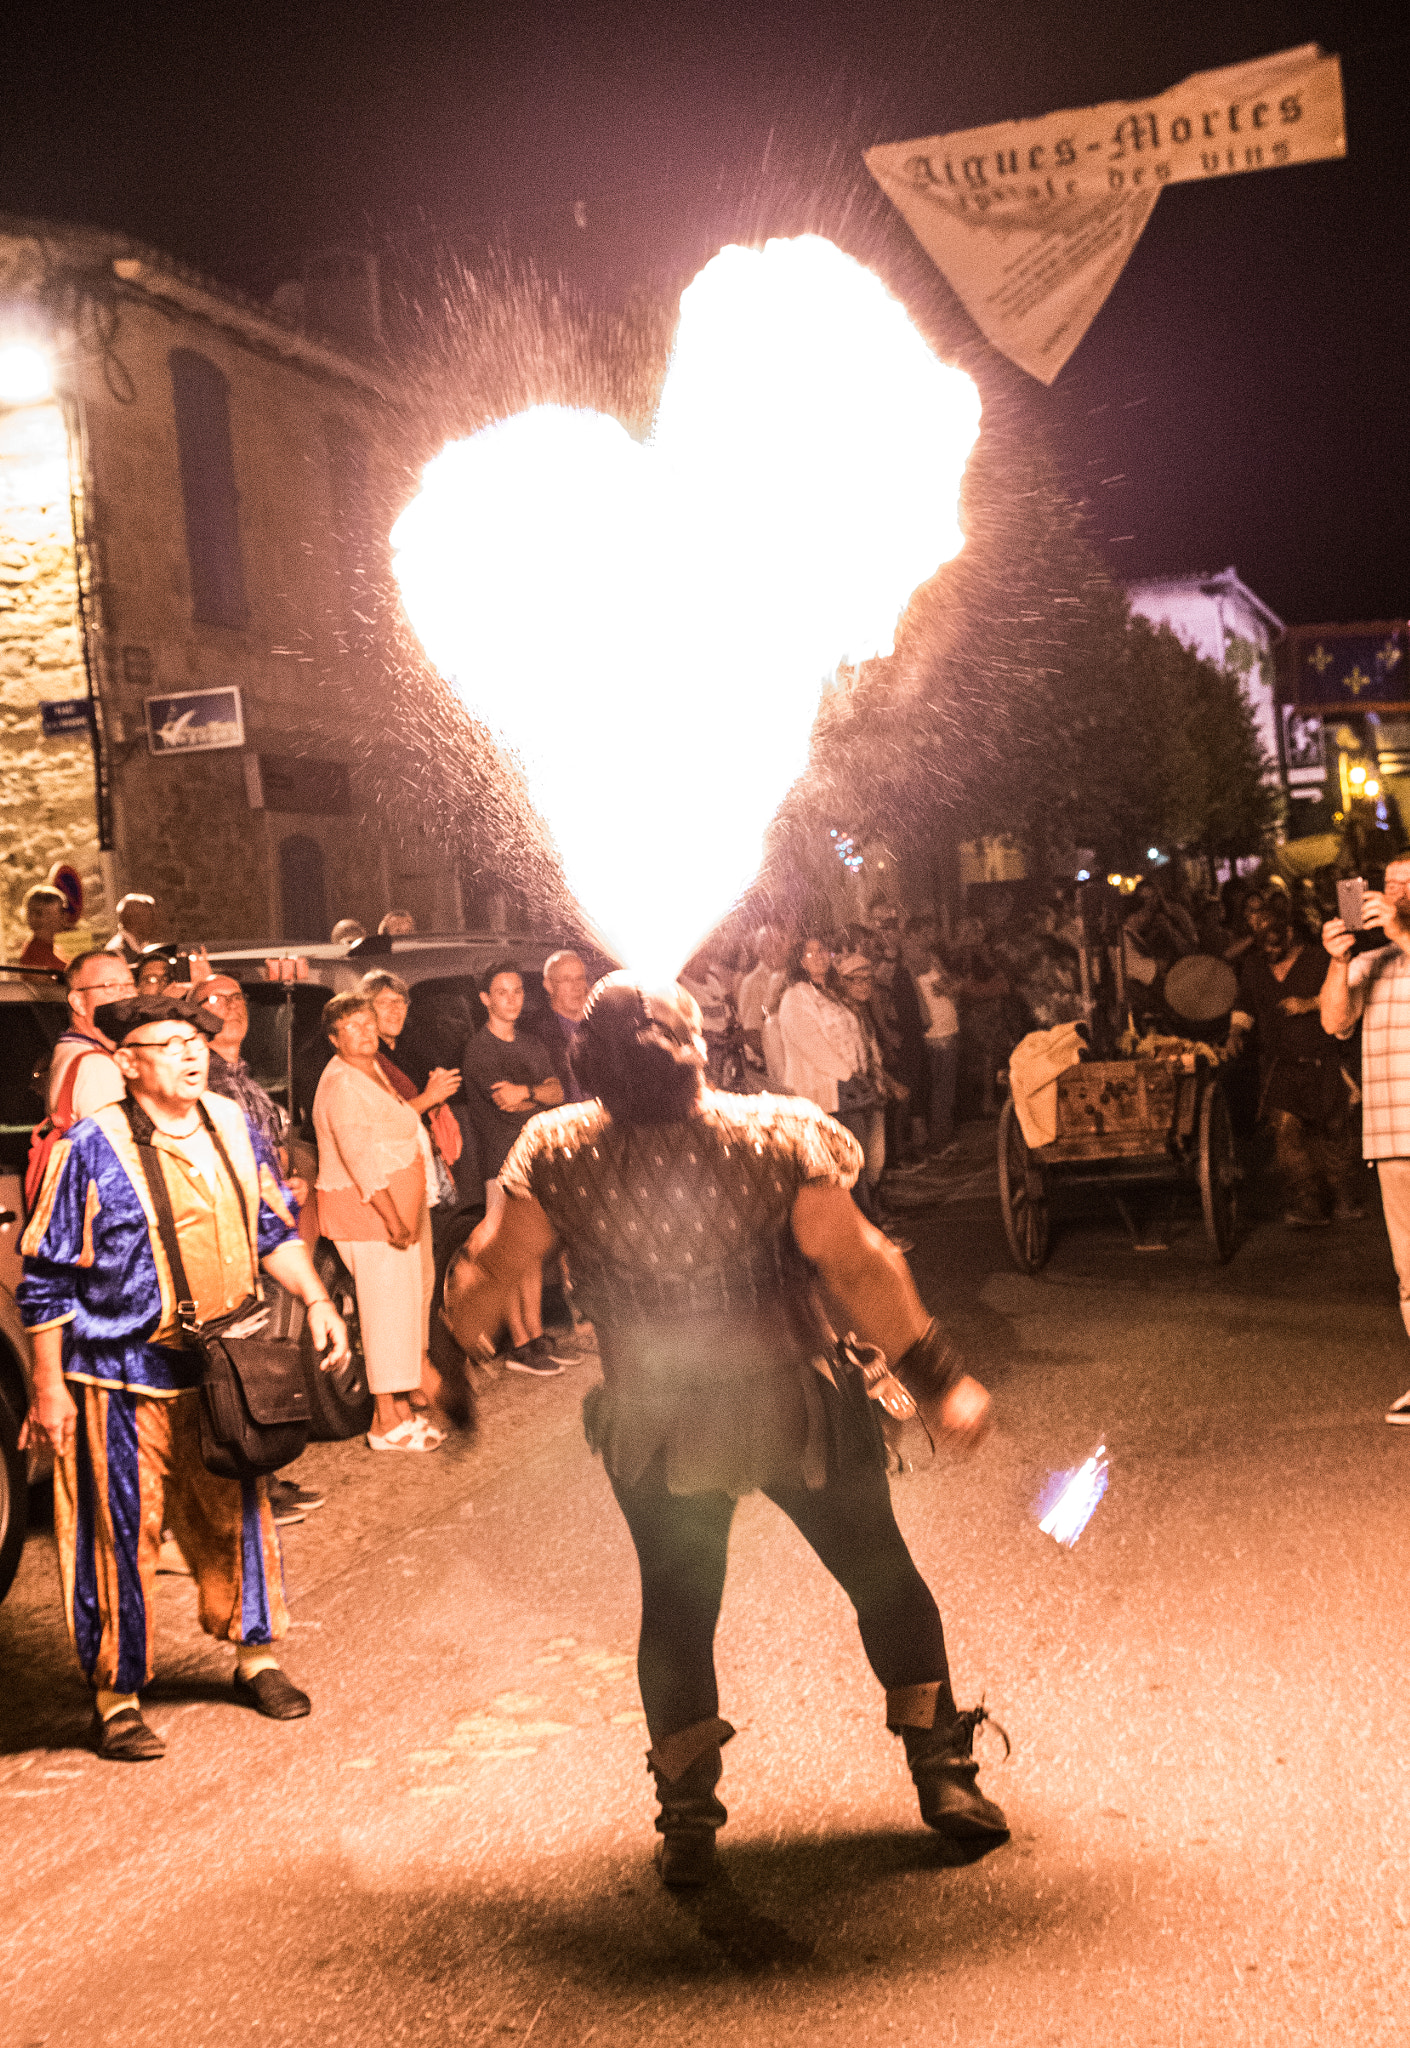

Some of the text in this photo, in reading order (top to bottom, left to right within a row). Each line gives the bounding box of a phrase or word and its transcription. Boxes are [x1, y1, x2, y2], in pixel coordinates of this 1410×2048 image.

[903, 94, 1303, 190] Aigues-Mortes
[1107, 161, 1172, 189] des
[1200, 138, 1292, 172] vins
